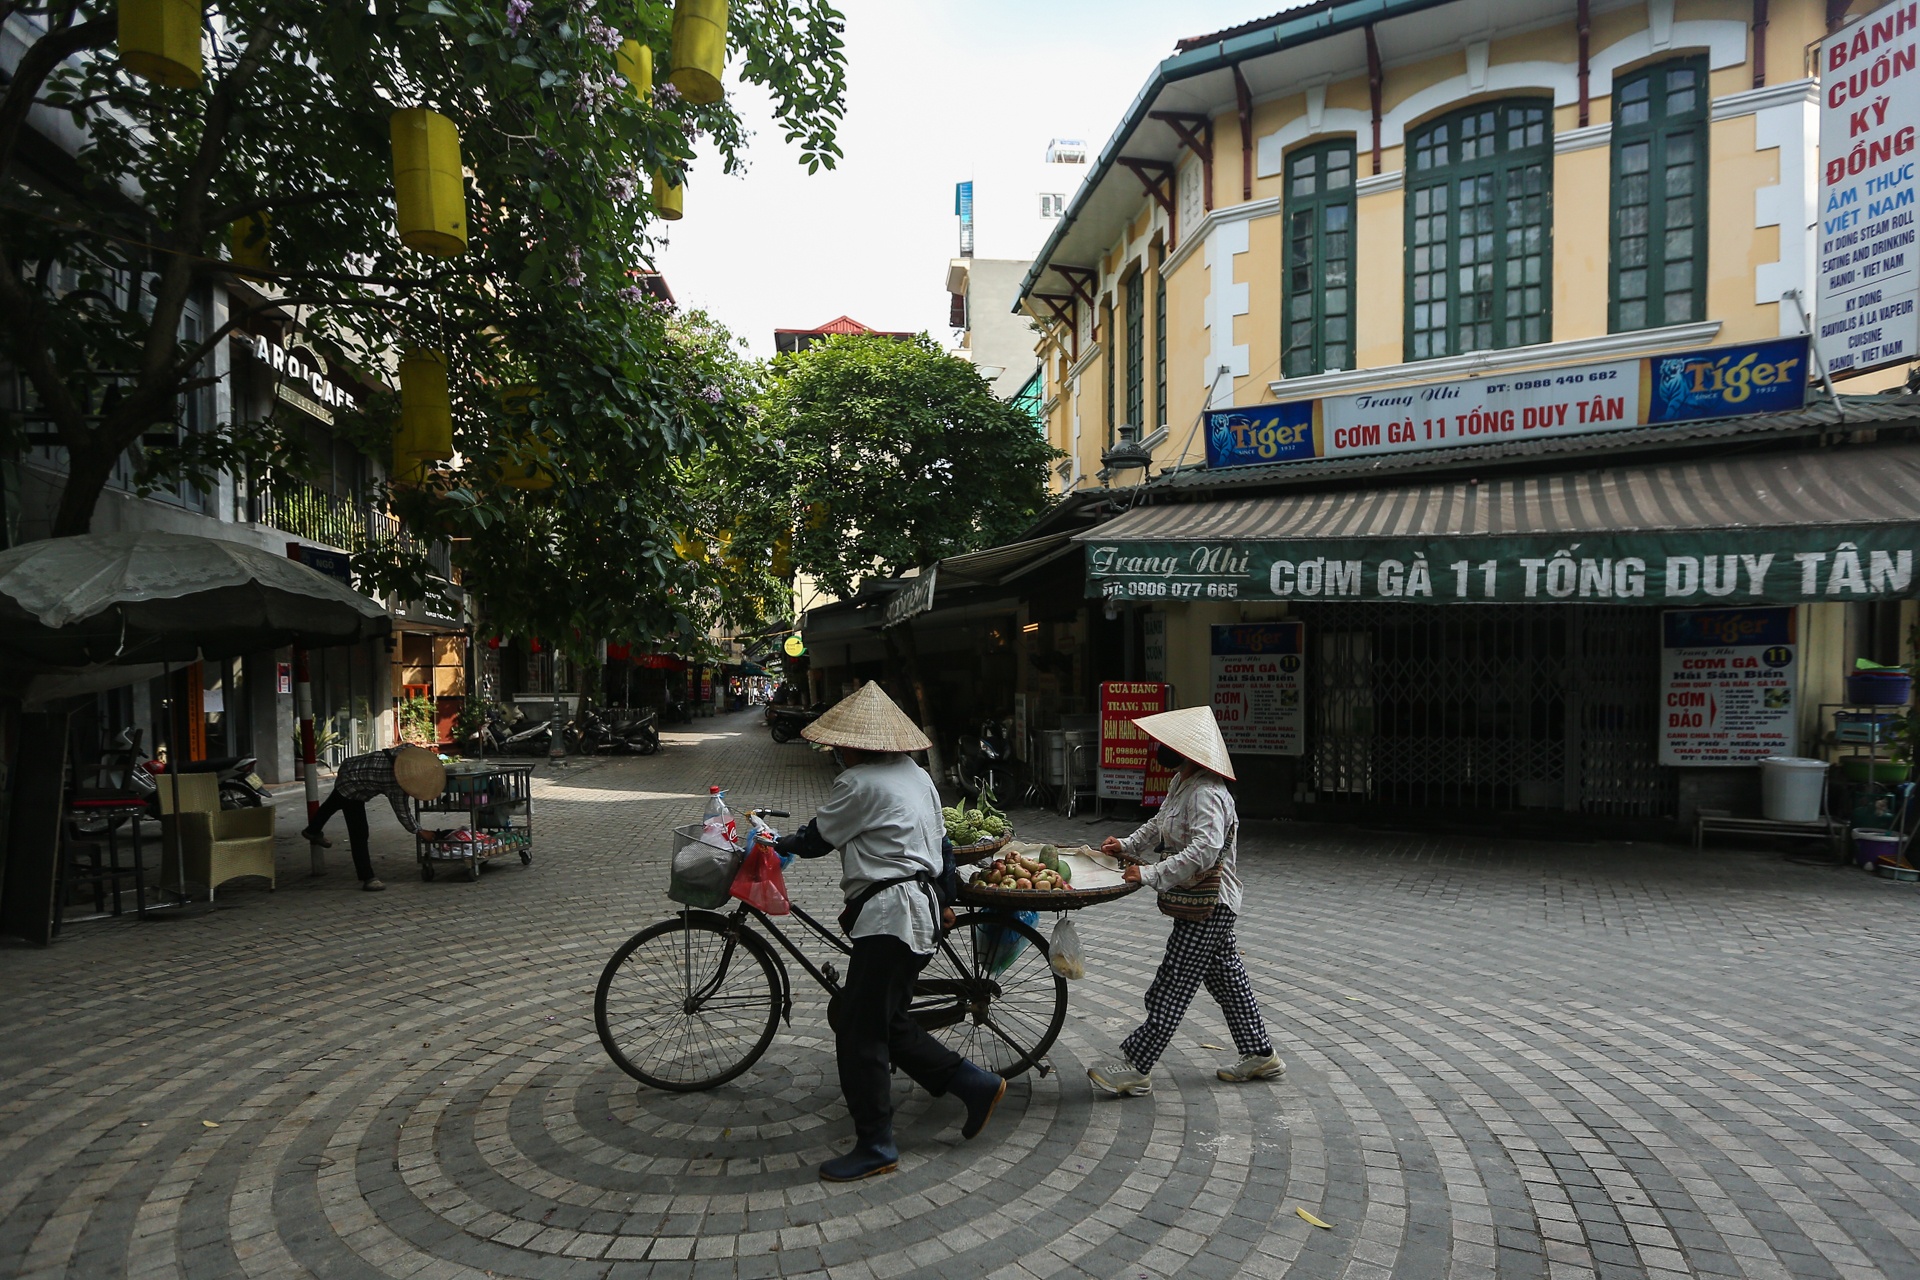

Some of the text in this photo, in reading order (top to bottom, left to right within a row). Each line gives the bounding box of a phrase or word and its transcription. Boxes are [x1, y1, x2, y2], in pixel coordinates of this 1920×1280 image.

[1828, 2, 1917, 73] BÁNH
[1828, 43, 1916, 109] CUỐN
[1850, 95, 1890, 139] KỲ
[1826, 126, 1914, 187] ĐỒNG
[1827, 162, 1914, 213] ẨM THỰC
[1825, 187, 1915, 235] VIỆT NAM
[1824, 211, 1914, 255] KY DONG STEAM ROLL
[1822, 230, 1915, 274] EATING AND DRINKING
[1830, 270, 1855, 289] HANOI
[1863, 261, 1881, 278] VIET
[1883, 253, 1904, 271] NAM
[1846, 289, 1882, 312] KY DONG
[1821, 316, 1857, 338] RAVIOLIS
[1867, 310, 1877, 325] LA
[1879, 299, 1913, 321] VAPEUR
[1848, 327, 1883, 349] CUISINE
[254, 334, 309, 381] AROI
[1828, 353, 1854, 372] HANOI
[1862, 346, 1880, 362] VIET
[1882, 340, 1902, 358] NAM
[1356, 393, 1413, 410] Trang
[1420, 386, 1460, 401] Nhi
[1514, 379, 1551, 391] 0988
[1556, 375, 1584, 386] 440
[1588, 370, 1618, 382] 682
[1684, 352, 1799, 403] Tiger
[1230, 417, 1309, 458] Tiger
[1334, 395, 1624, 449] CƠM GÀ 11 TỐNG DUY TÂN
[1092, 546, 1250, 578] Trang Nhi
[1269, 541, 1913, 598] CƠM GÀ 11 TỐNG DUY TÂN
[1128, 581, 1167, 596] 0906
[1171, 582, 1202, 597] 077
[1207, 583, 1238, 597] 665
[1232, 628, 1283, 652] Tiger
[1694, 614, 1769, 643] Tiger
[1224, 662, 1277, 673] CƠM GÀ
[1283, 656, 1297, 668] 11
[1682, 658, 1726, 669] CƠM
[1732, 656, 1759, 668] GÀ
[1768, 648, 1787, 662] 11
[1107, 701, 1159, 711] TRANG NHI
[1214, 691, 1240, 704] CƠM
[1215, 706, 1239, 721] ĐẢO
[1667, 691, 1705, 707] CƠM
[1104, 715, 1117, 739] BÁN
[1668, 708, 1702, 728] ĐẢO
